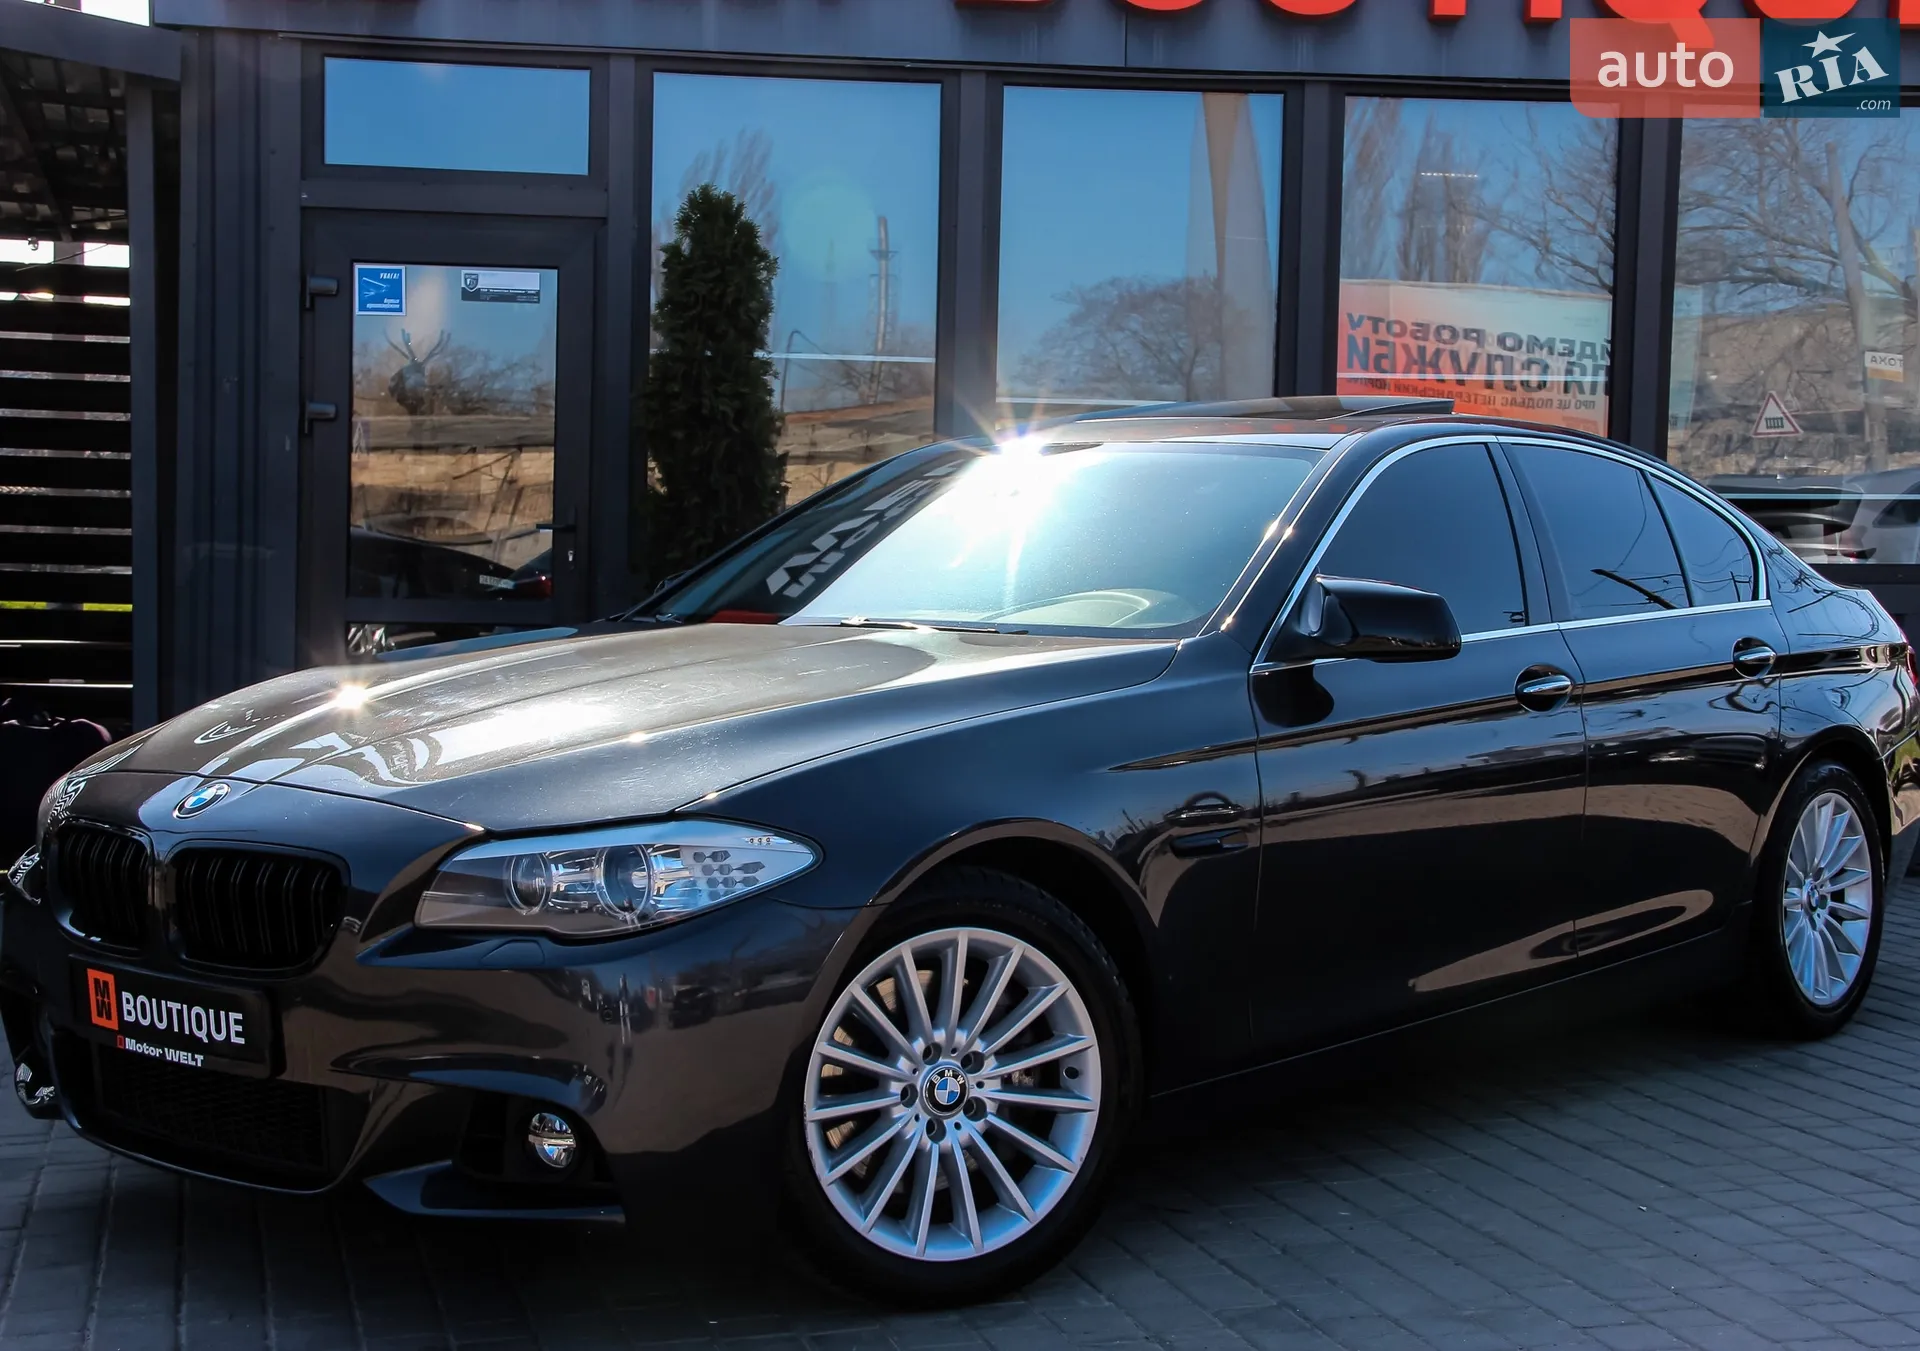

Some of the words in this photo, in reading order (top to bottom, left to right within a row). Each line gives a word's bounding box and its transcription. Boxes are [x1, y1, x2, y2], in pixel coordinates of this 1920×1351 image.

[121, 991, 245, 1045] BOUTIQUE
[125, 1037, 163, 1058] Motor
[164, 1047, 205, 1068] WELT
